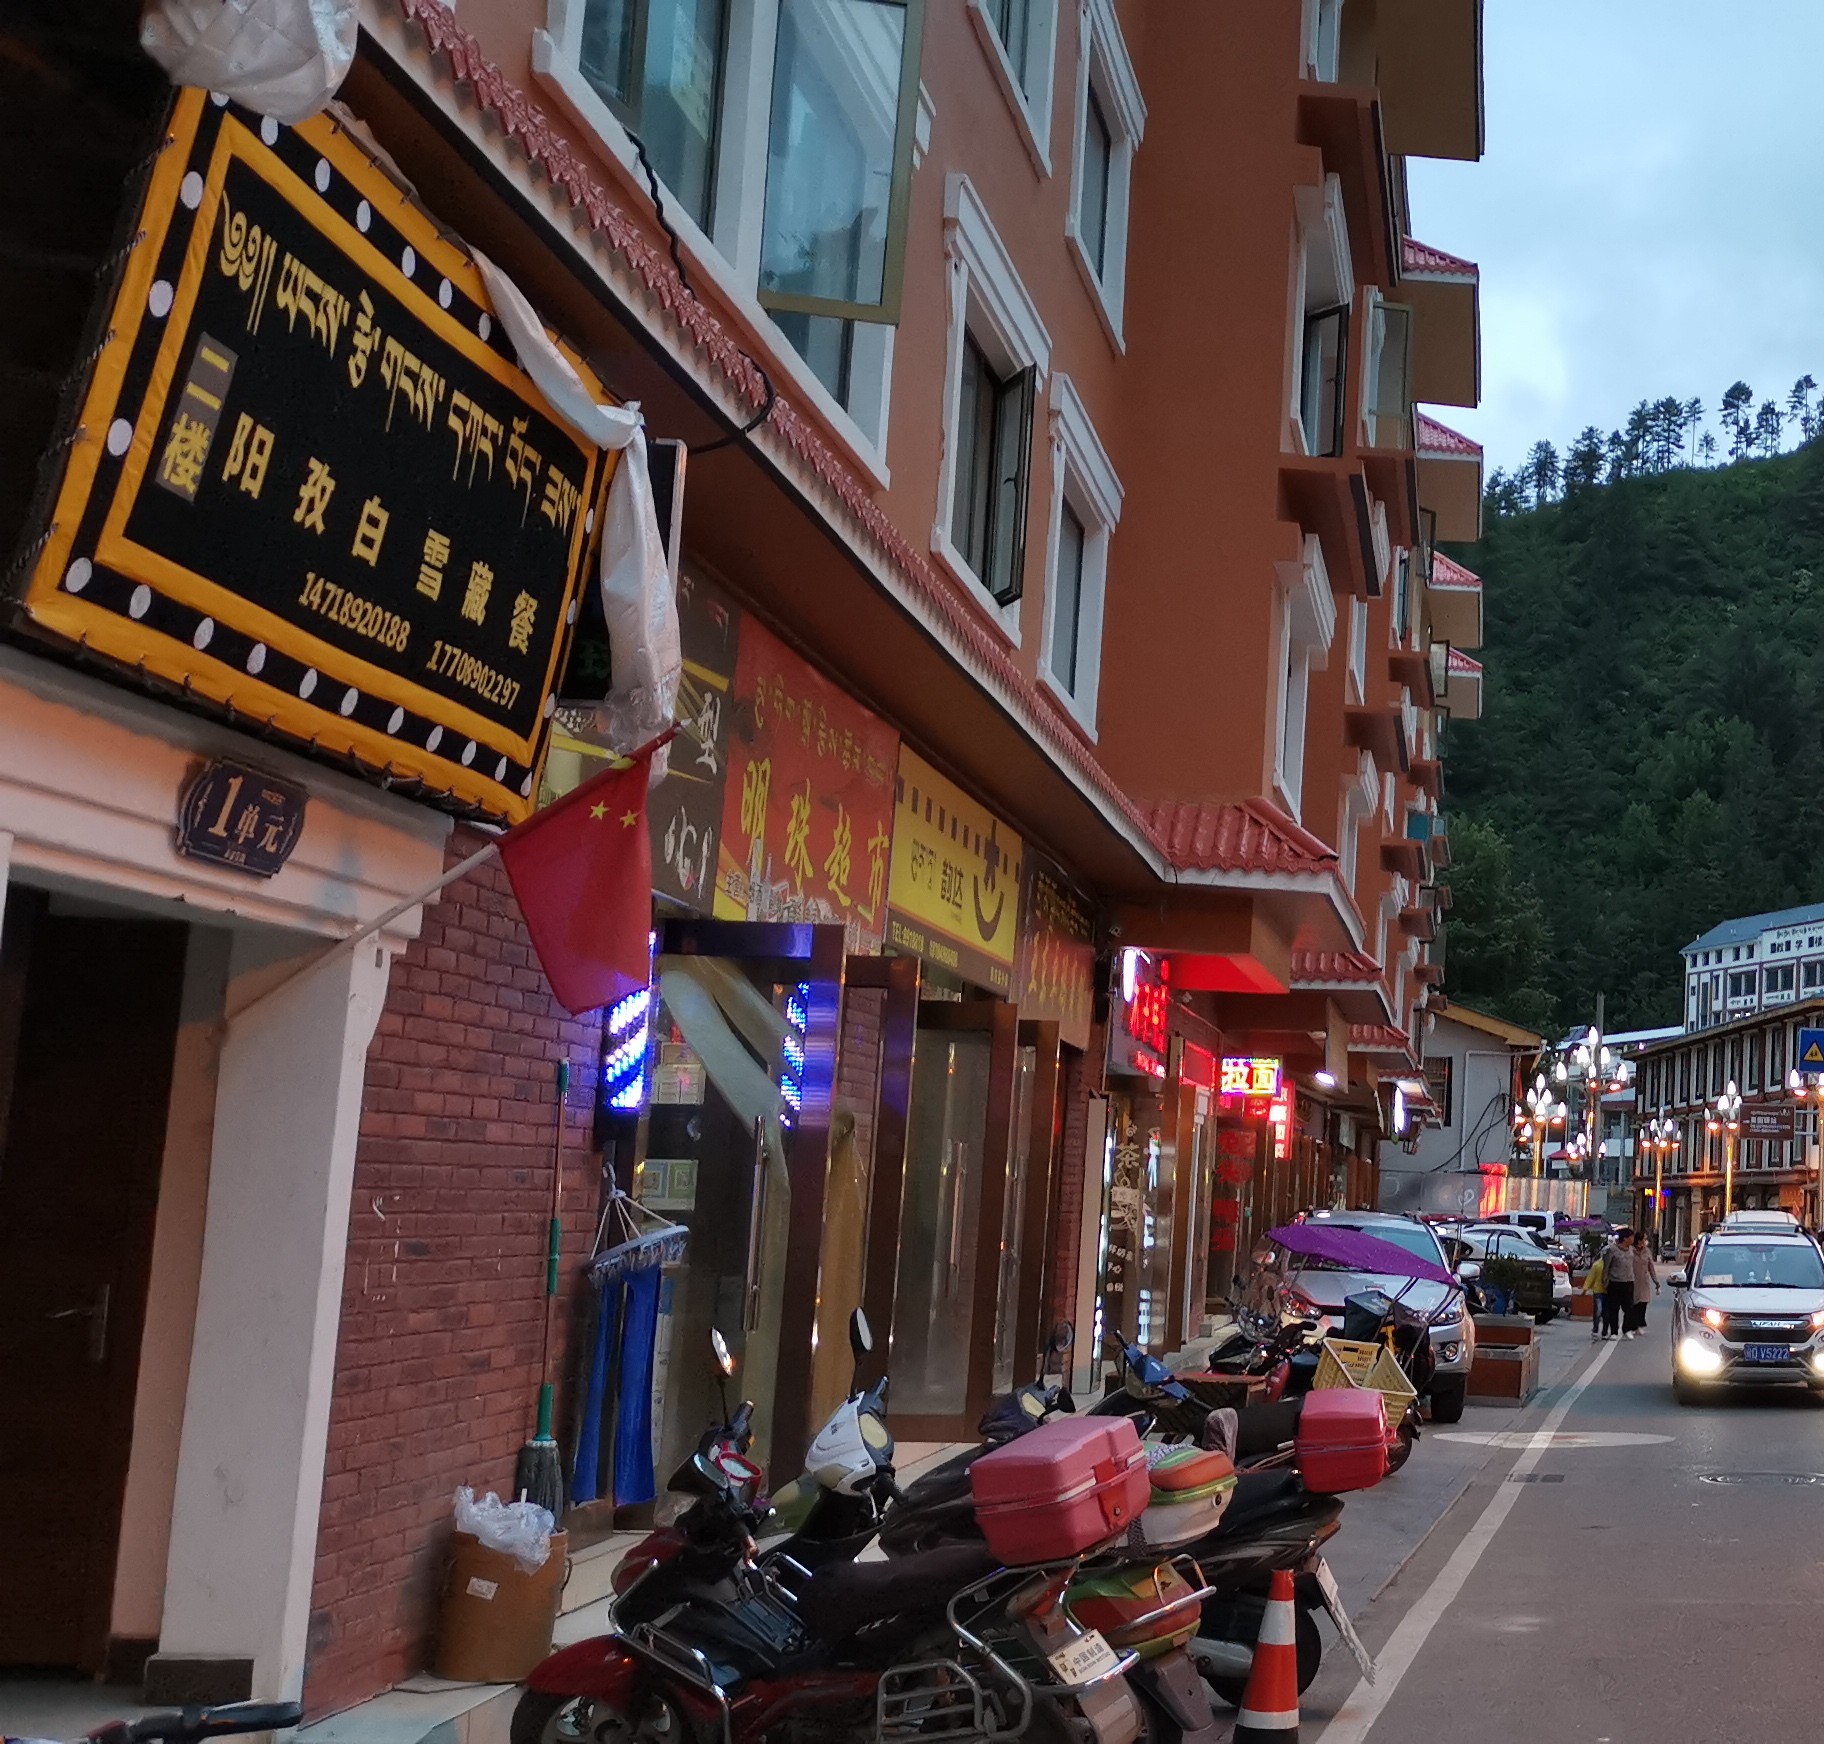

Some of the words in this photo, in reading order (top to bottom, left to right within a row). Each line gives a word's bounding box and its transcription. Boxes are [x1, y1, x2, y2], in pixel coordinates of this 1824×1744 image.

[162, 347, 230, 494] 二楼
[222, 411, 538, 655] 阳孜白雪藏餐
[299, 571, 410, 652] 14718920188
[426, 640, 520, 710] 17708902297
[741, 757, 890, 930] 明珠超市
[1221, 1058, 1277, 1091] 拉面
